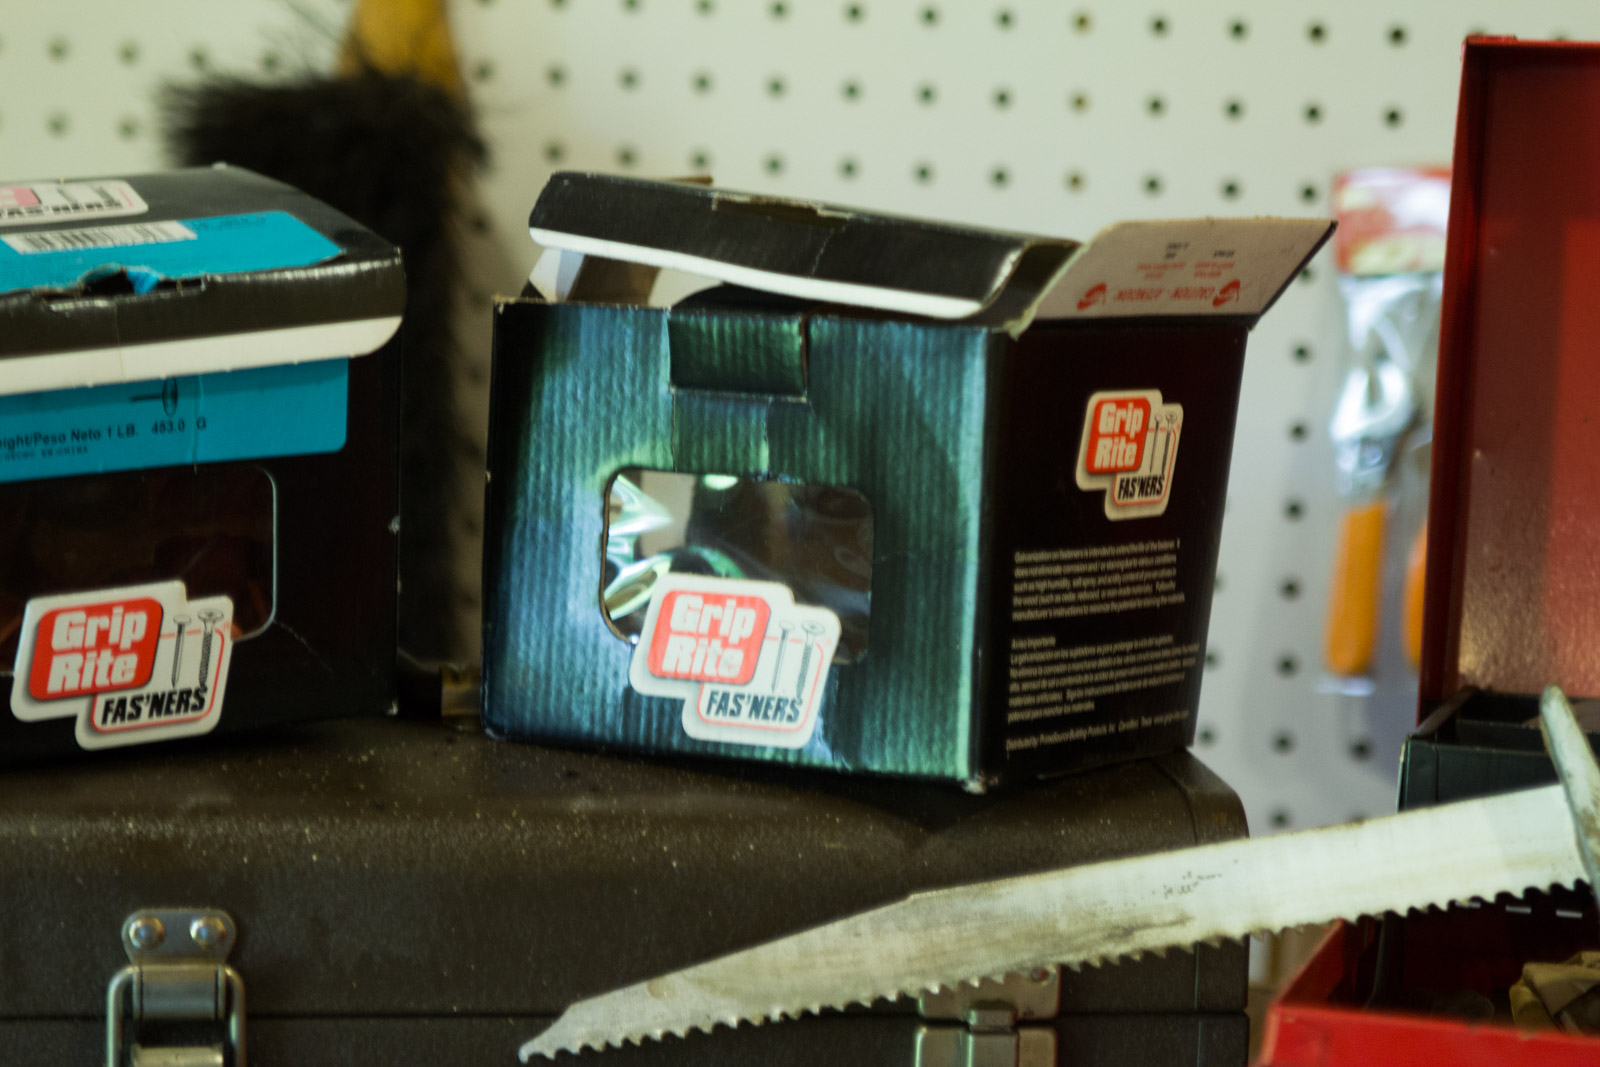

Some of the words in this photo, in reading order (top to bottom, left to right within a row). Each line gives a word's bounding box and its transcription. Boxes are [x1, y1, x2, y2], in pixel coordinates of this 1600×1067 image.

[71, 427, 101, 443] Neto
[1098, 402, 1144, 439] Grip
[1094, 436, 1138, 469] Rite
[1117, 474, 1165, 500] FAS'NERS
[51, 605, 148, 651] Grip
[670, 594, 757, 645] Grip
[47, 648, 139, 694] Rite
[661, 634, 744, 679] Rite
[100, 686, 208, 726] FAS'NERS
[705, 690, 803, 723] FAS'NERS
